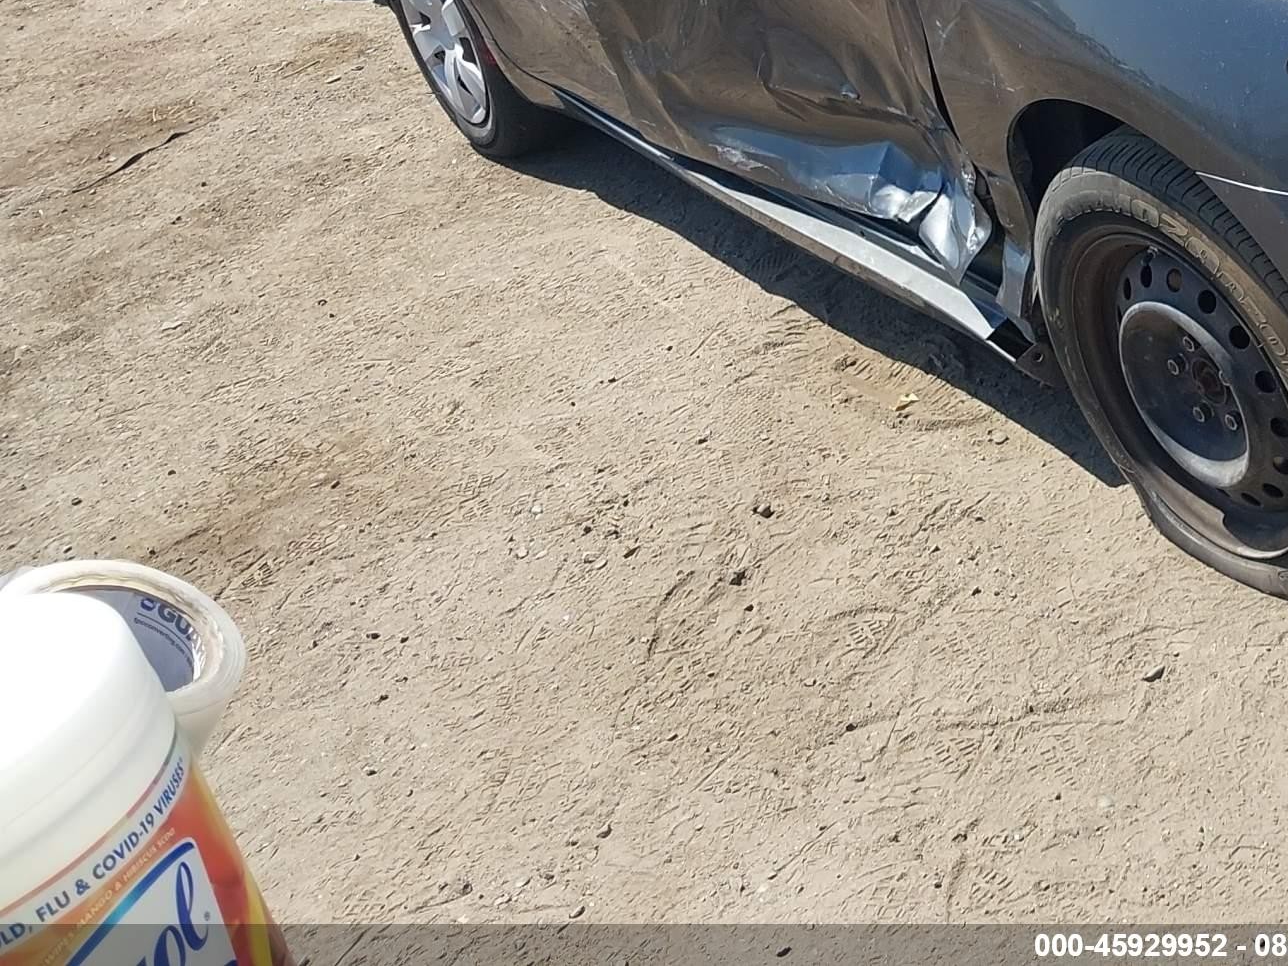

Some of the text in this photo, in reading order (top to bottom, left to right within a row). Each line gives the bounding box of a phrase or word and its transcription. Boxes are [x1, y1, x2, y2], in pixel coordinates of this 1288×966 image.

[0, 922, 33, 948] LD,
[35, 891, 71, 922] FLU
[75, 878, 91, 896] &
[92, 812, 155, 880] COVID-19
